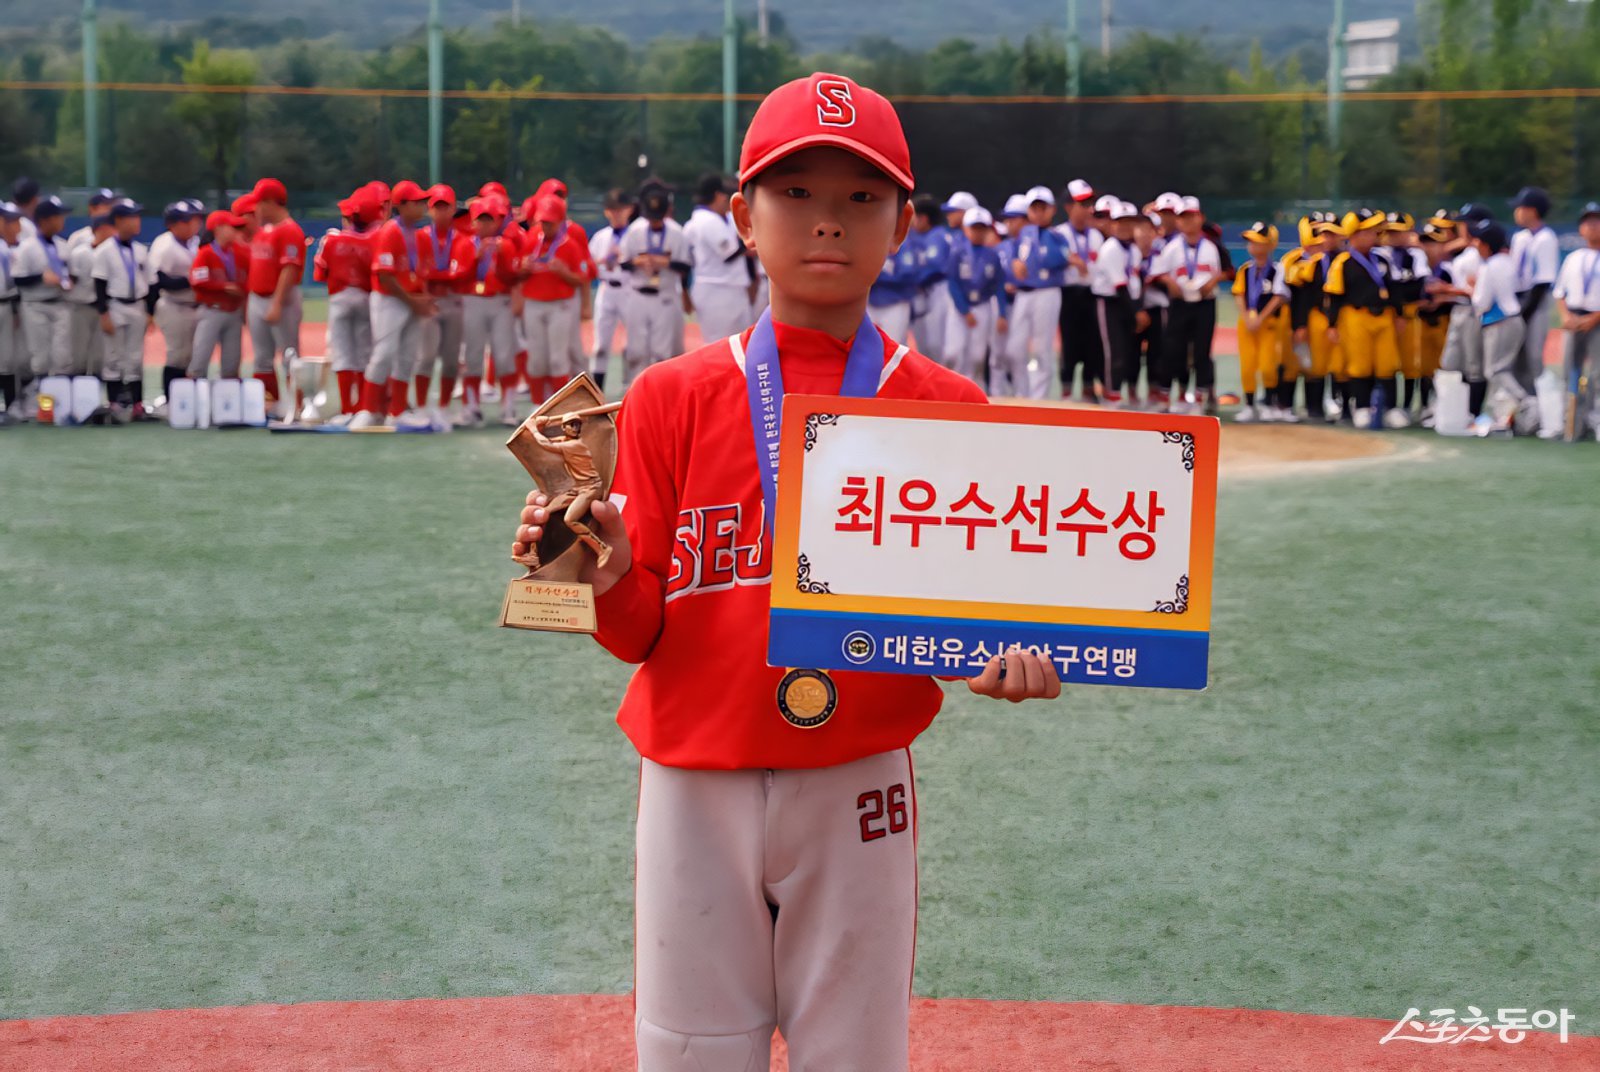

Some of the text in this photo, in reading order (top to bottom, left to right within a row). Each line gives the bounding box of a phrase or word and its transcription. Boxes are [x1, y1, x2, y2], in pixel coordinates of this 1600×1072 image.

[817, 80, 856, 127] S
[835, 476, 1165, 561] 최우수선수상
[857, 783, 908, 843] 26
